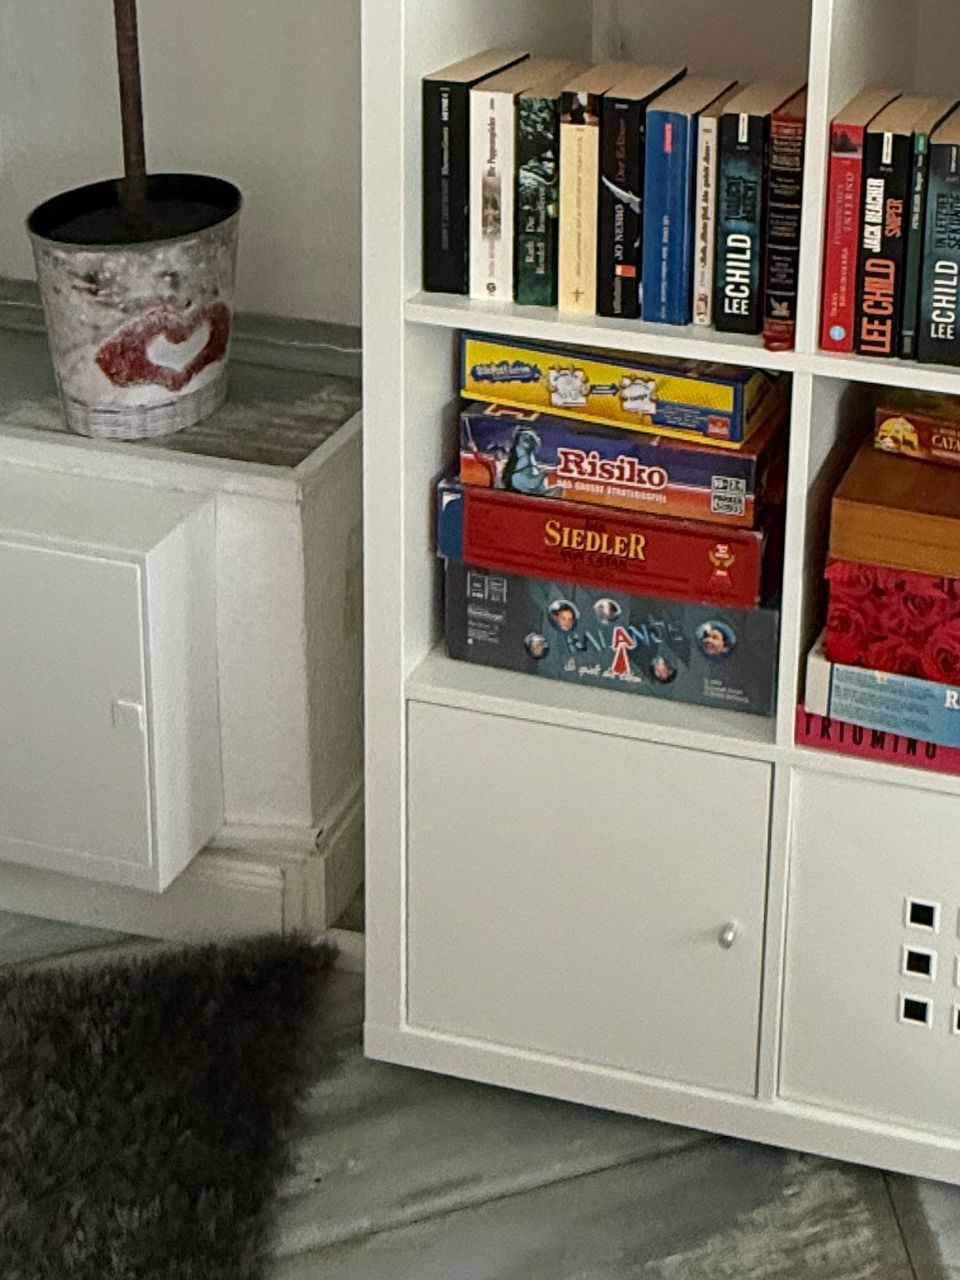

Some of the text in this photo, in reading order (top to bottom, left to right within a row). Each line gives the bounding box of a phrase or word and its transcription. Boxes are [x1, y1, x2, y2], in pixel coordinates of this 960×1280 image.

[862, 223, 884, 253] JACK
[725, 233, 752, 298] CHILD
[724, 297, 750, 315] LEE
[860, 258, 897, 353] LEE CHILD
[929, 260, 959, 340] LEE CHILD
[557, 447, 669, 490] Risiko
[543, 519, 647, 561] SIEDLER
